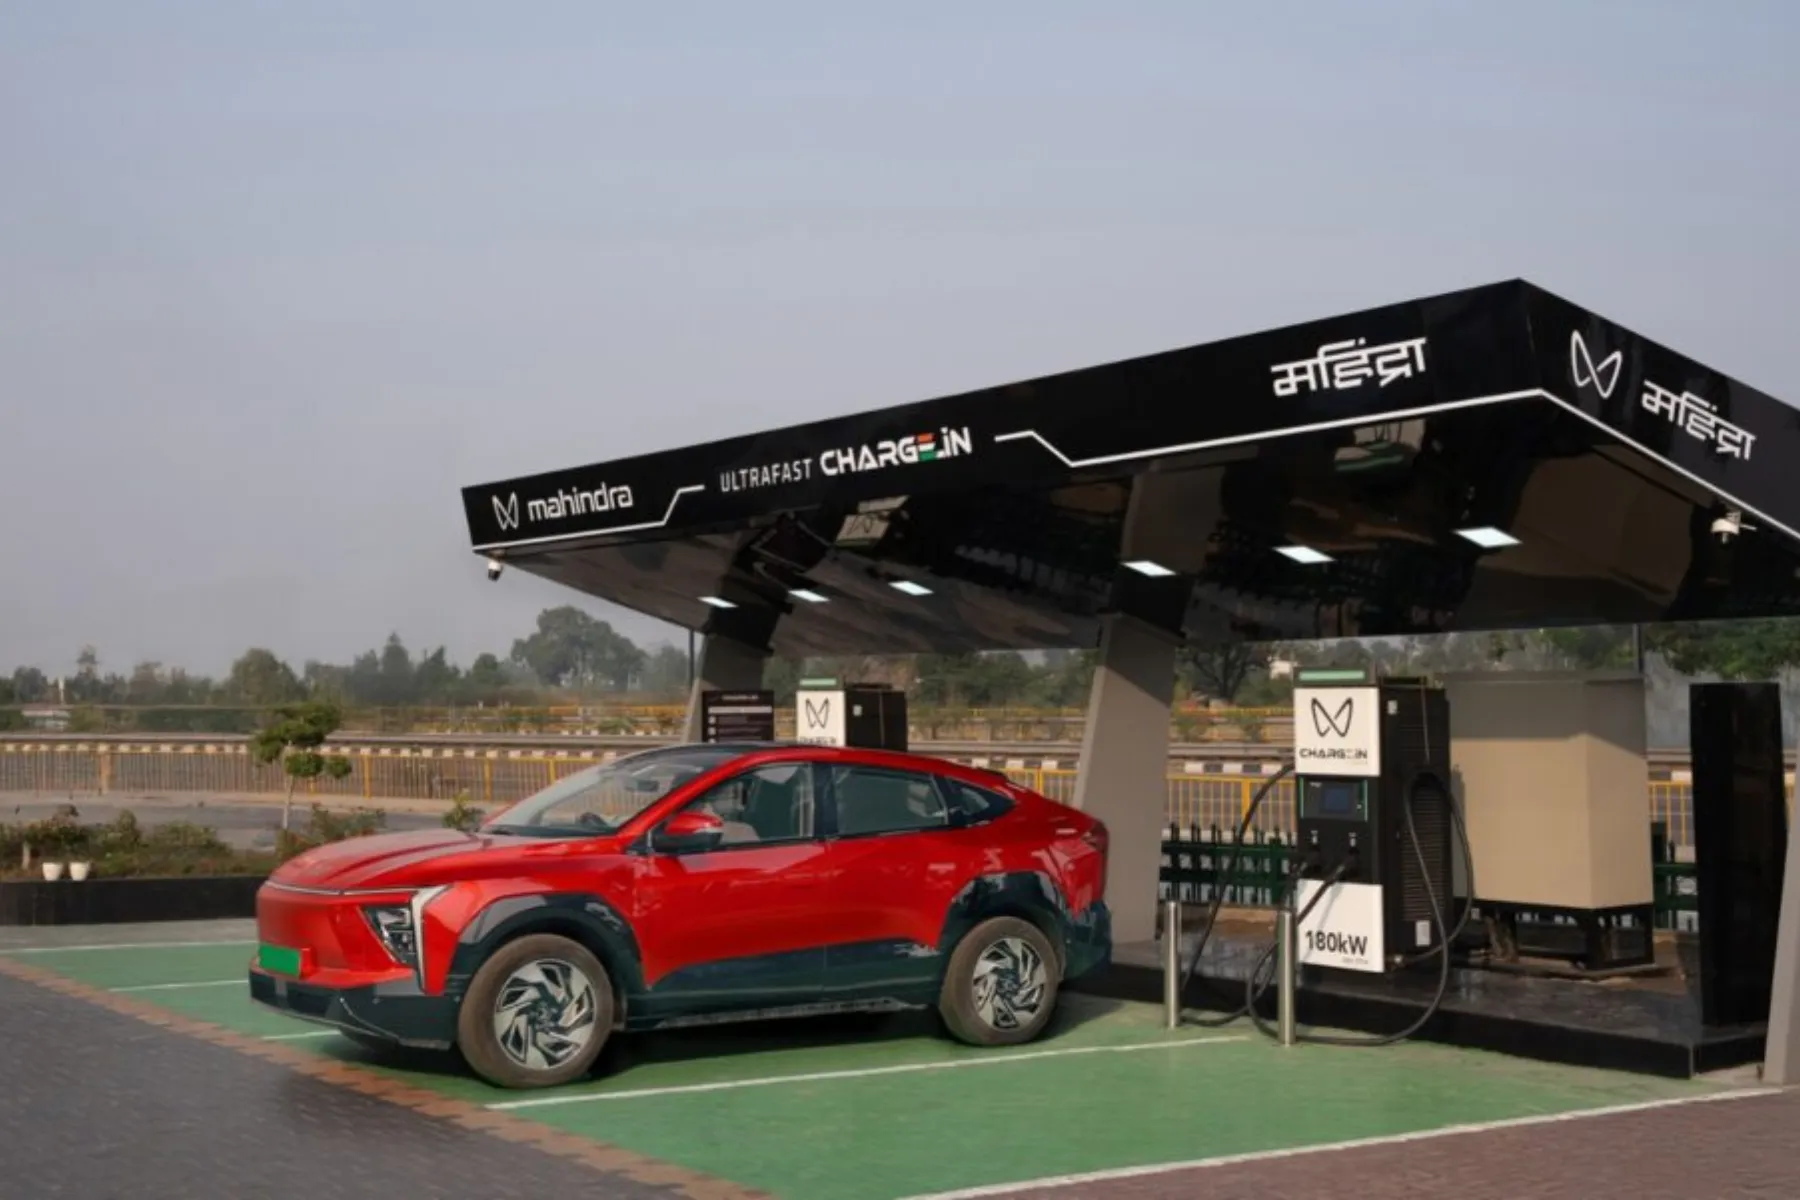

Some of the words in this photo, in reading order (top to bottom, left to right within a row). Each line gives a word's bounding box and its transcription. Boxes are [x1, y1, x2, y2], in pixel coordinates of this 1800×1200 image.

[1270, 337, 1428, 397] महिंद्रा
[1641, 380, 1757, 461] महिंद्रा
[719, 457, 813, 493] ULTRAFAST
[527, 480, 634, 522] mahindra
[1305, 929, 1368, 957] 180kW
